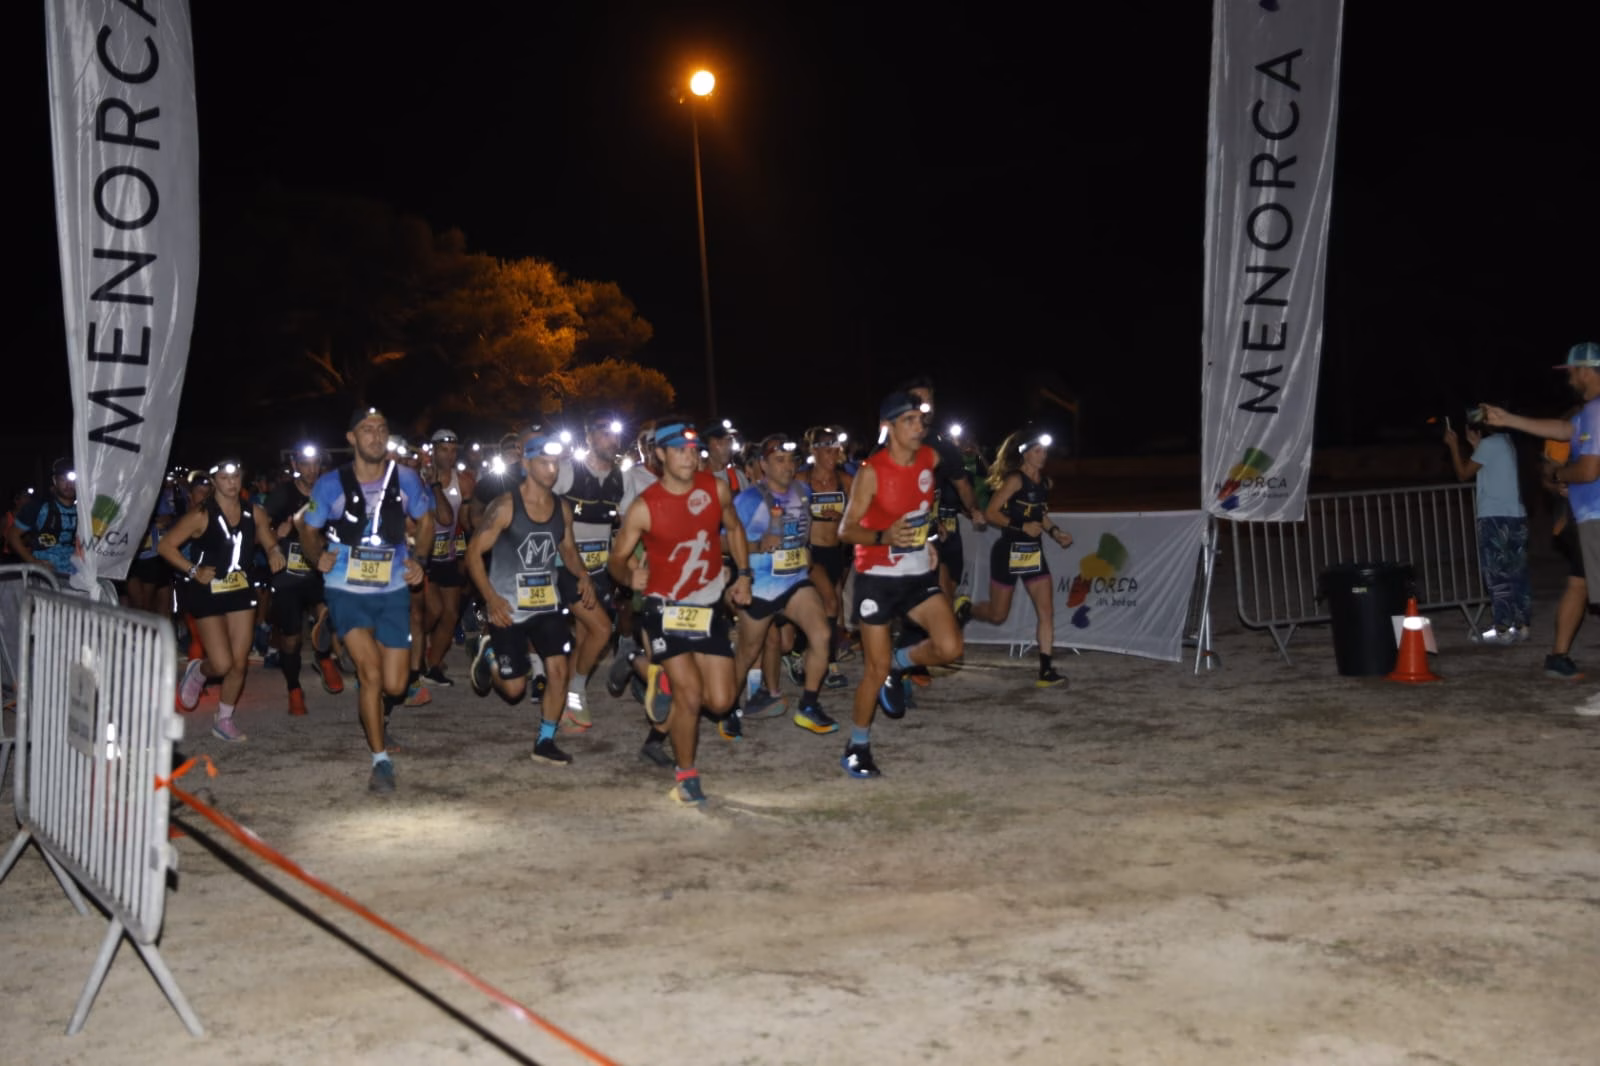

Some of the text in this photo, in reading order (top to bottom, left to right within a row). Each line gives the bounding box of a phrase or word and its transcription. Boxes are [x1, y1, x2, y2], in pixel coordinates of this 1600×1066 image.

[1238, 48, 1303, 414] MENORCA
[361, 561, 380, 574] 387
[677, 608, 699, 621] 327
